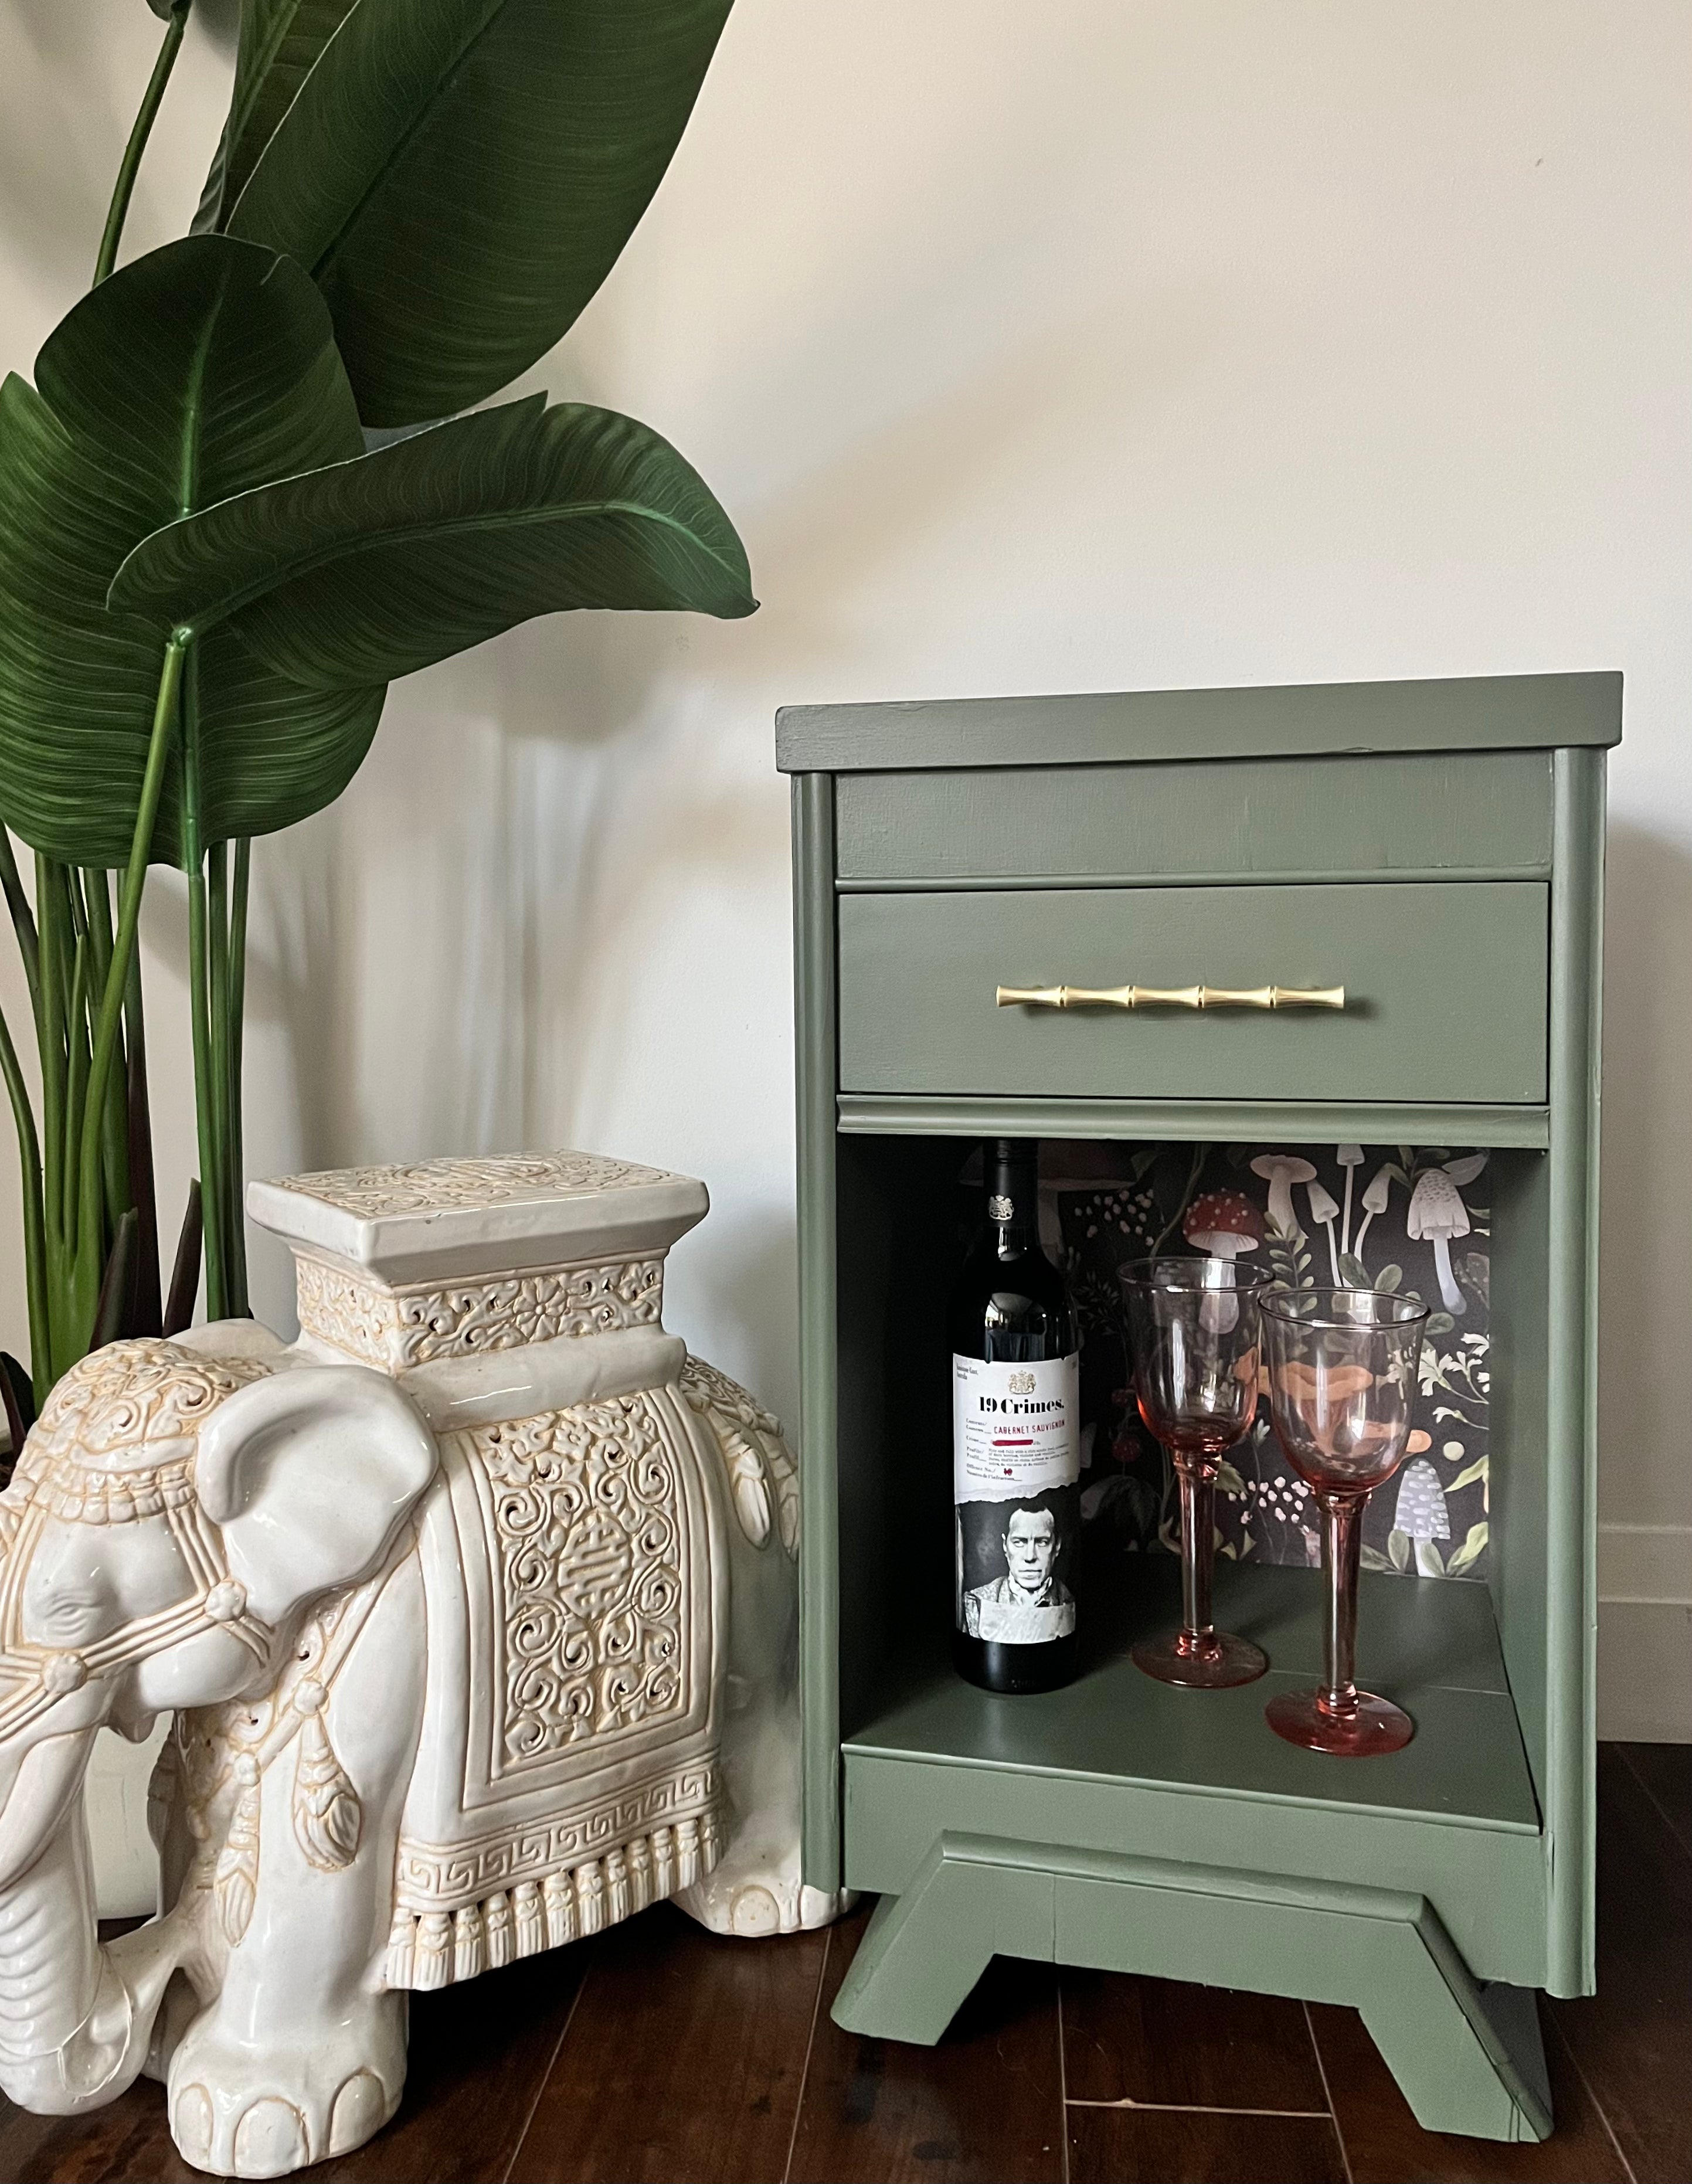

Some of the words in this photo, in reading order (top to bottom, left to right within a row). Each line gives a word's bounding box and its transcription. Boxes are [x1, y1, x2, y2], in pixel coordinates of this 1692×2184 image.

[979, 1397, 997, 1412] 19
[1001, 1399, 1065, 1414] Crimes.
[994, 1426, 1029, 1435] CABERNET
[1032, 1419, 1065, 1433] SAUVIGNON
